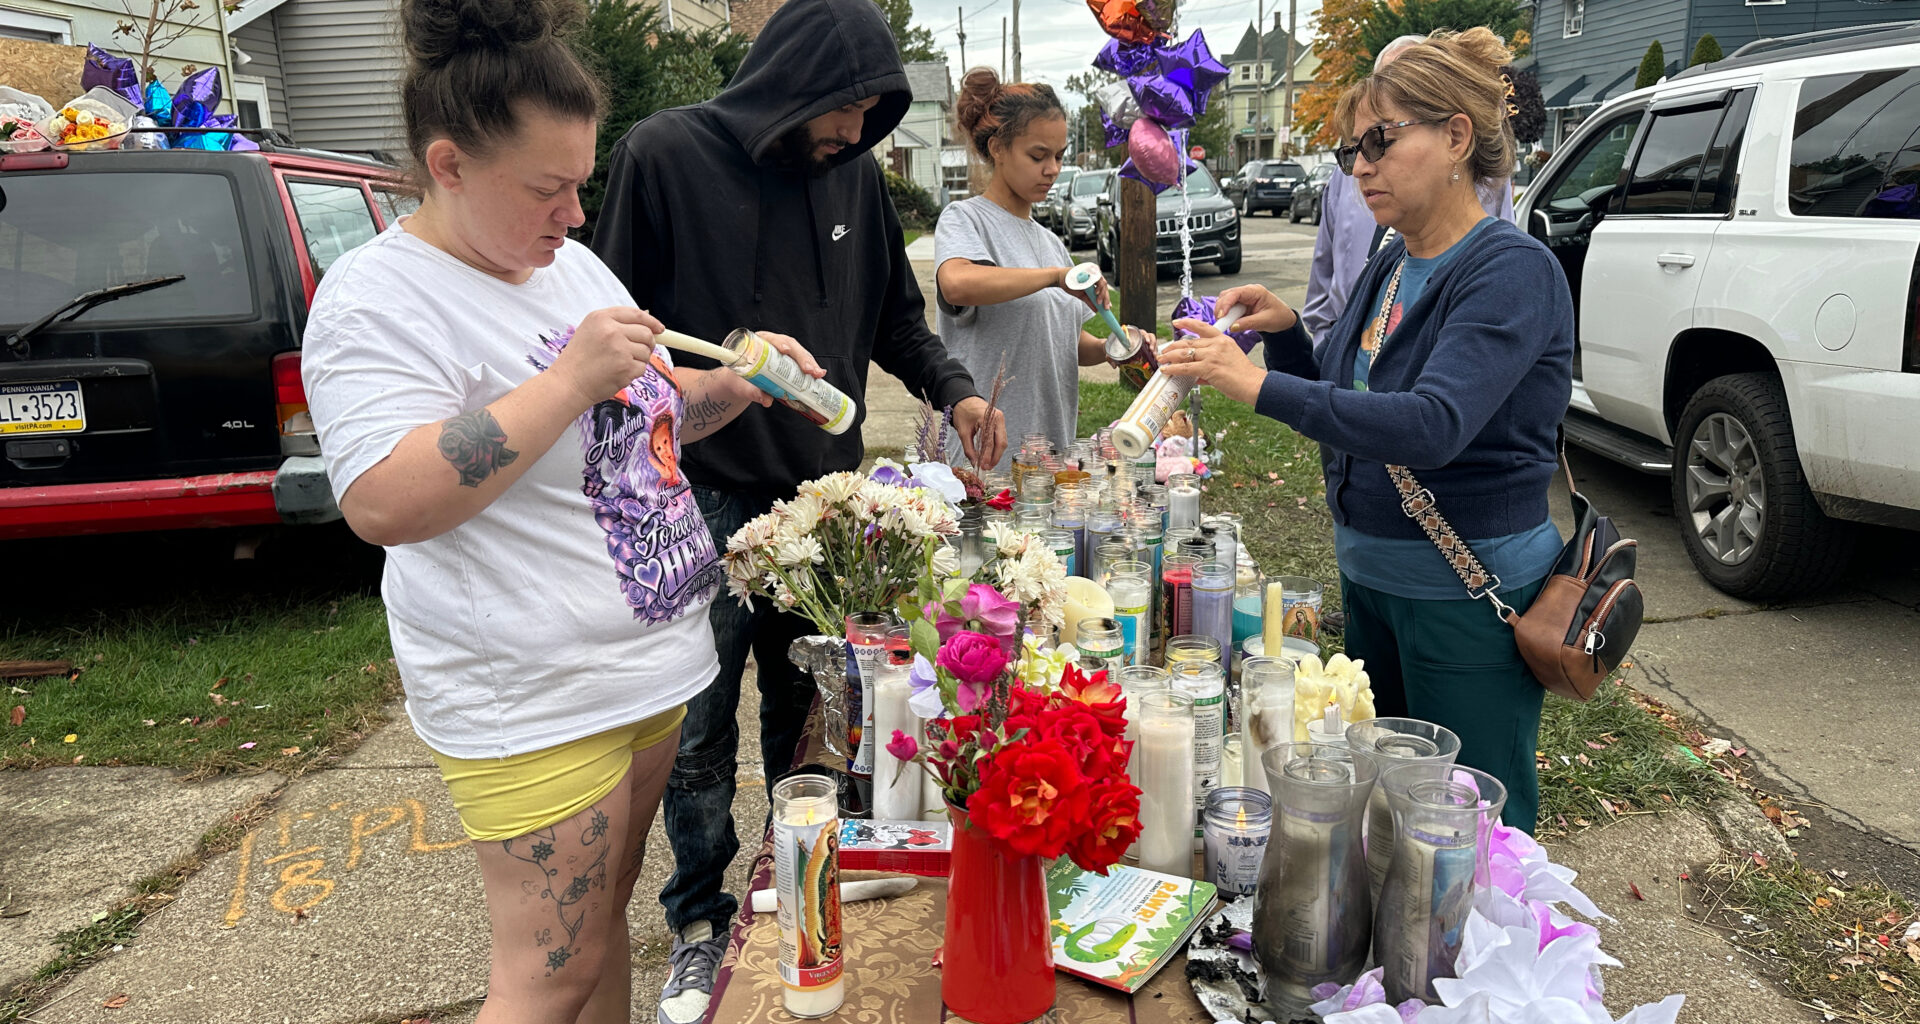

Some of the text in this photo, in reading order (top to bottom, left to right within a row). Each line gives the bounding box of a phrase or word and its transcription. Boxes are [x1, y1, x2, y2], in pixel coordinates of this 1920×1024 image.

[1, 384, 55, 393] PENNSYLVANIA
[15, 423, 53, 431] visitPA.com
[585, 407, 645, 465] Angelina
[1132, 881, 1179, 923] RAWR!
